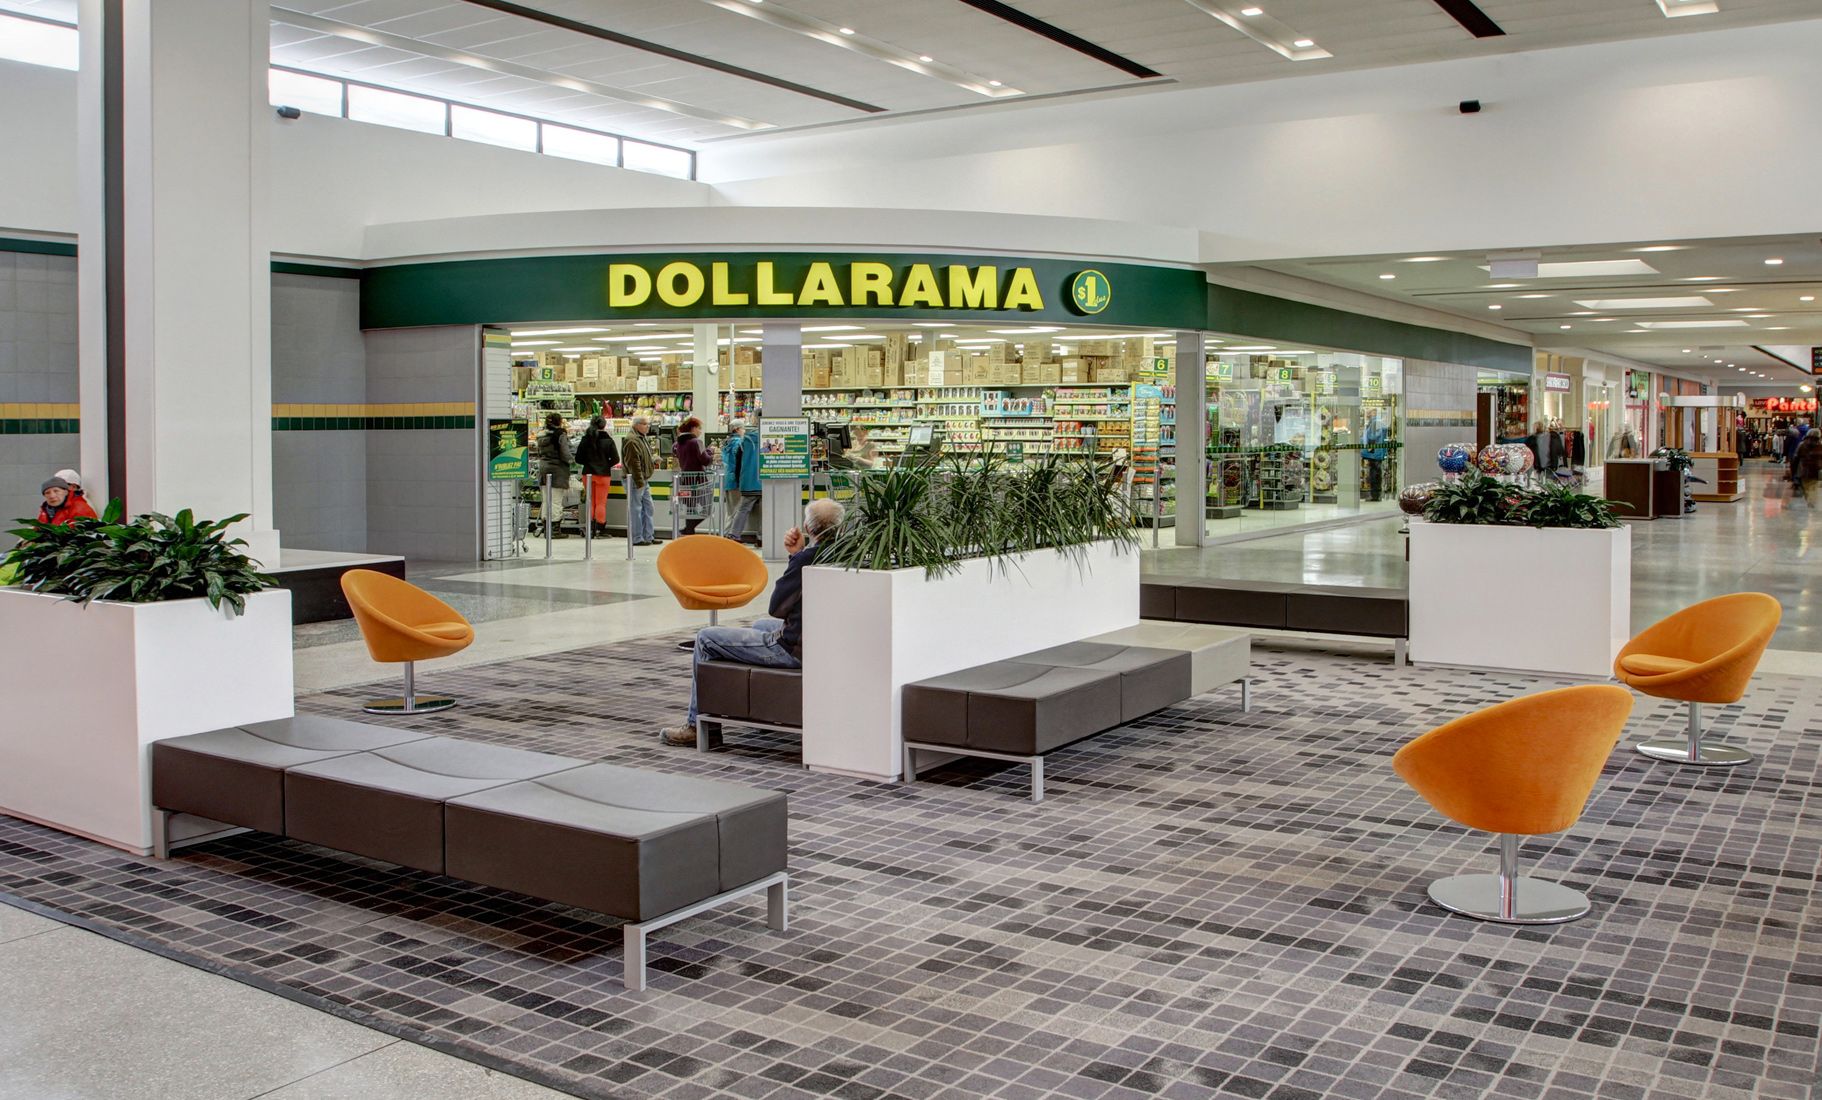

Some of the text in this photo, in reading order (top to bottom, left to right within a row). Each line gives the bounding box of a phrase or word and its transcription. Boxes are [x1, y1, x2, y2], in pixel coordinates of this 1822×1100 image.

[608, 261, 1045, 310] DOLLARAMA
[1077, 275, 1098, 307] $1
[1156, 359, 1166, 370] 6
[1222, 364, 1229, 373] 7
[544, 369, 551, 379] 5
[1281, 369, 1288, 379] 8
[1329, 374, 1337, 383] 9
[1369, 378, 1379, 386] 10
